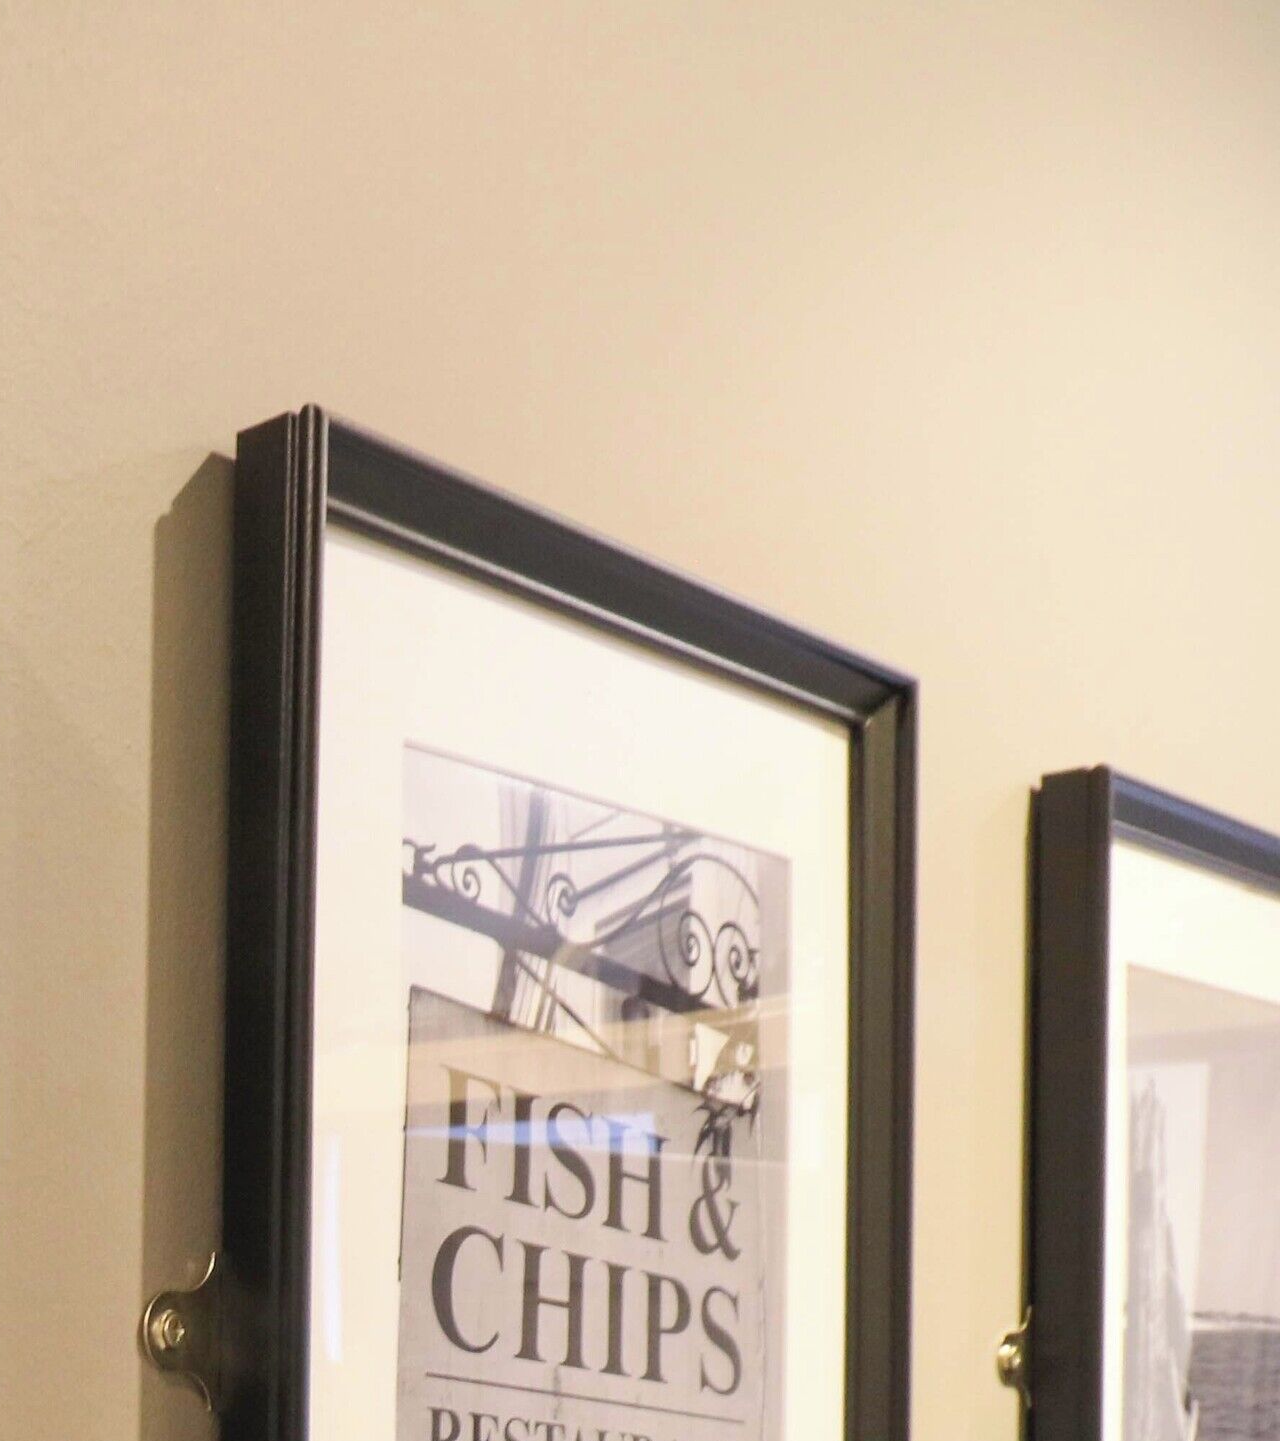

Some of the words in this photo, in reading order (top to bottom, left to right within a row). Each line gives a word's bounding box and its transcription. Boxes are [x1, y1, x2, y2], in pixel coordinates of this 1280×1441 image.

[436, 1065, 670, 1243] FISH
[689, 1157, 742, 1262] &
[431, 1224, 742, 1396] CHIPS
